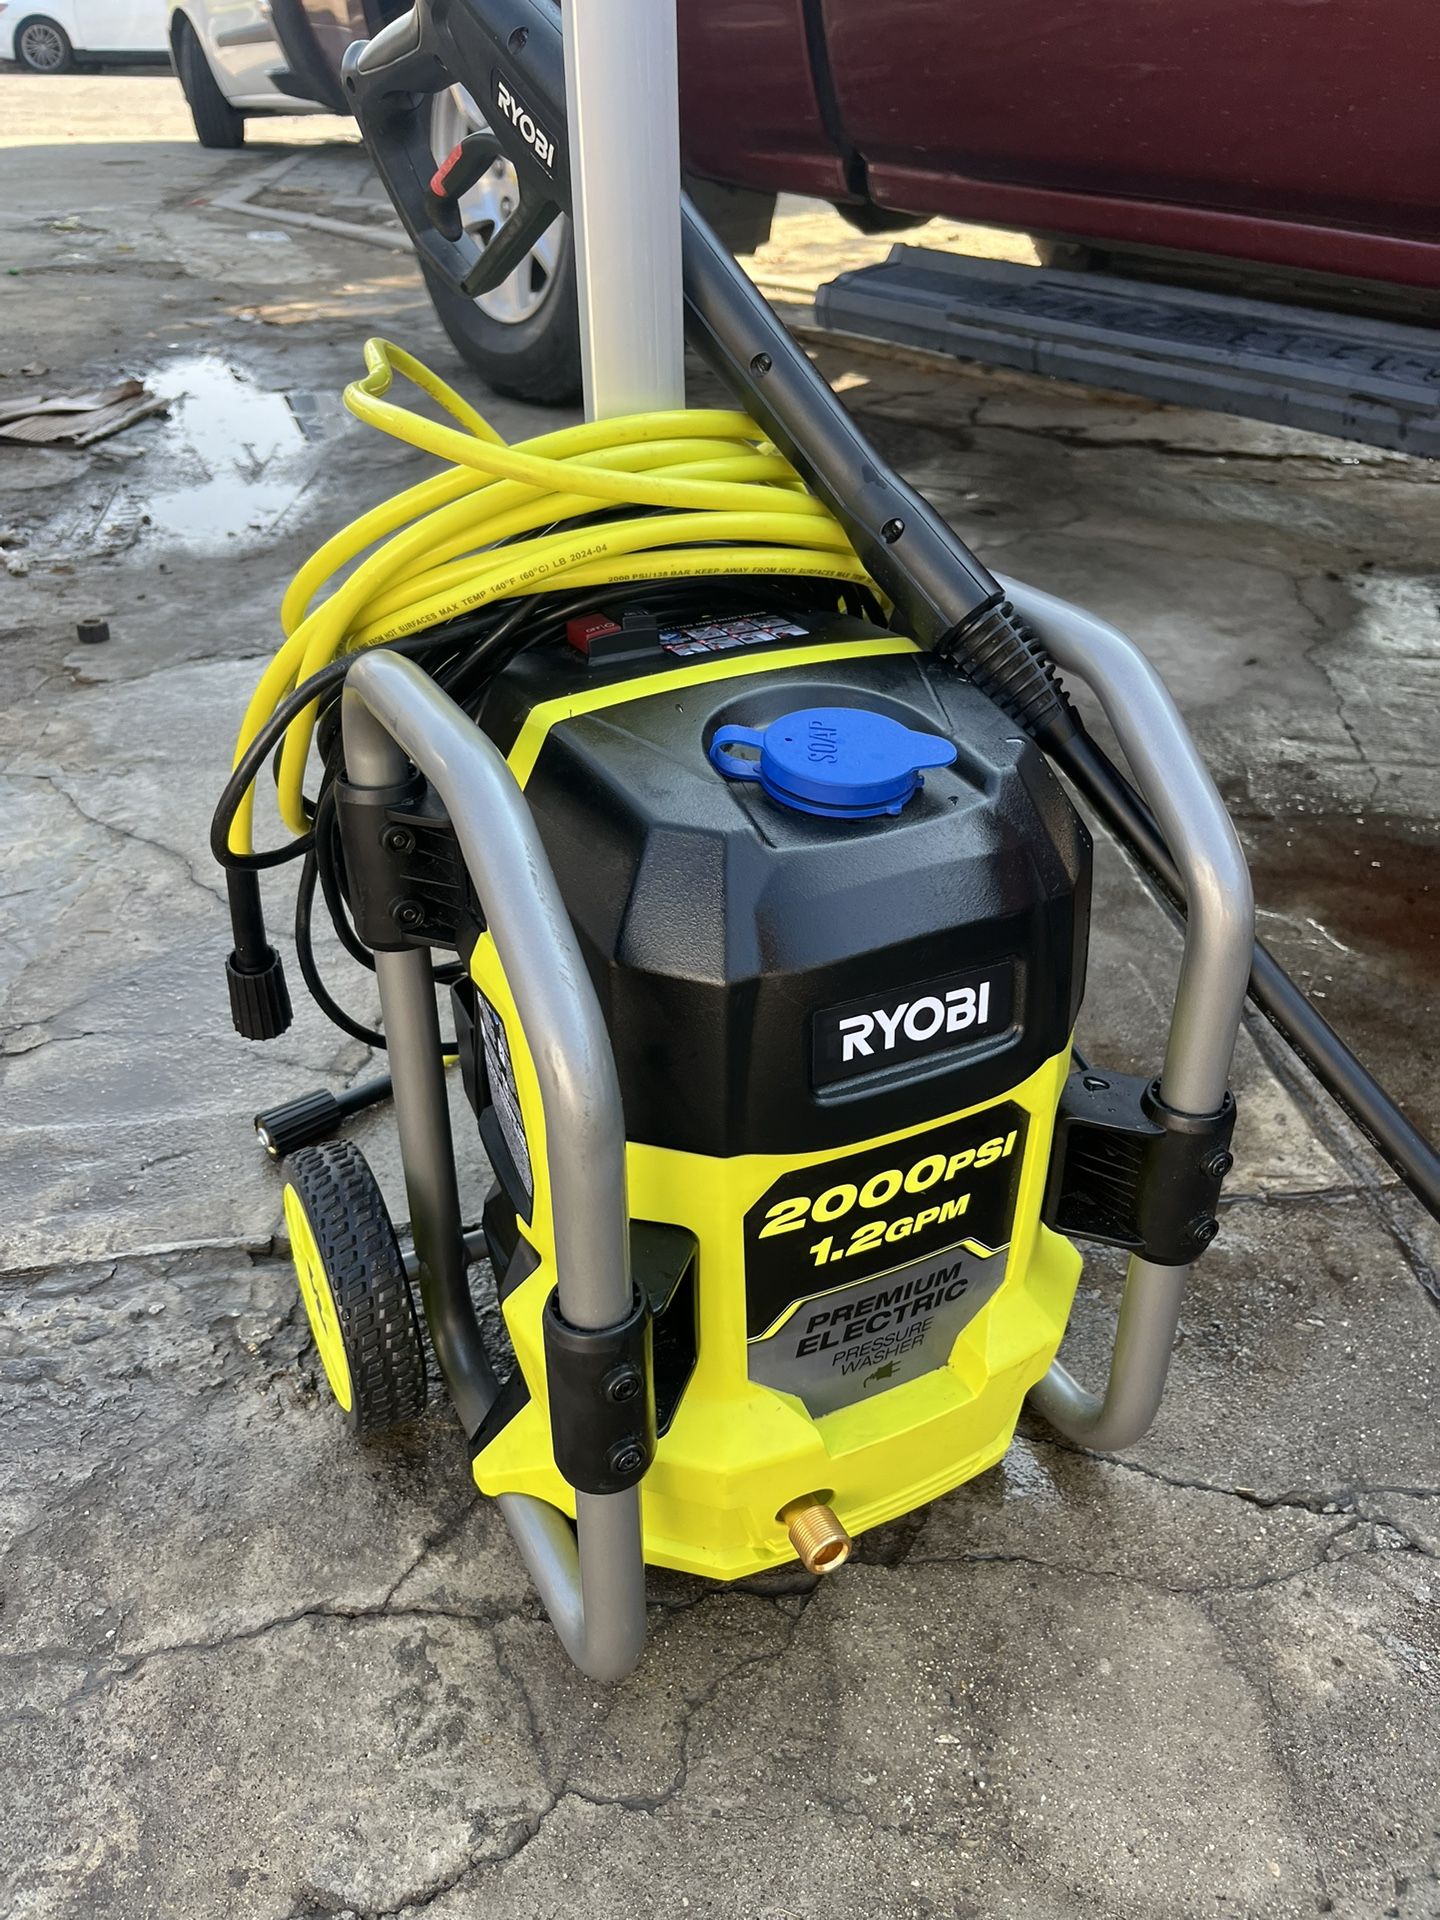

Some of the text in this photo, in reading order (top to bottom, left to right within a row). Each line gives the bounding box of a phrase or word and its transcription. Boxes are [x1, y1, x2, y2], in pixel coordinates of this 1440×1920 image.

[498, 81, 555, 168] RYOBI
[385, 629, 398, 640] HOT
[398, 612, 438, 632] SURFACES
[439, 603, 460, 616] MAX
[461, 590, 487, 607] TEMP
[553, 557, 567, 568] LB
[570, 543, 608, 562] 2024-04
[798, 568, 836, 577] SURFACES
[808, 720, 839, 764] SOAP
[838, 981, 990, 1063] RYOBI
[795, 1278, 969, 1360] ELECTRIC
[806, 1261, 963, 1335] PREMIUM
[831, 1315, 934, 1367] PRESSURE
[840, 1333, 926, 1377] WASHER
